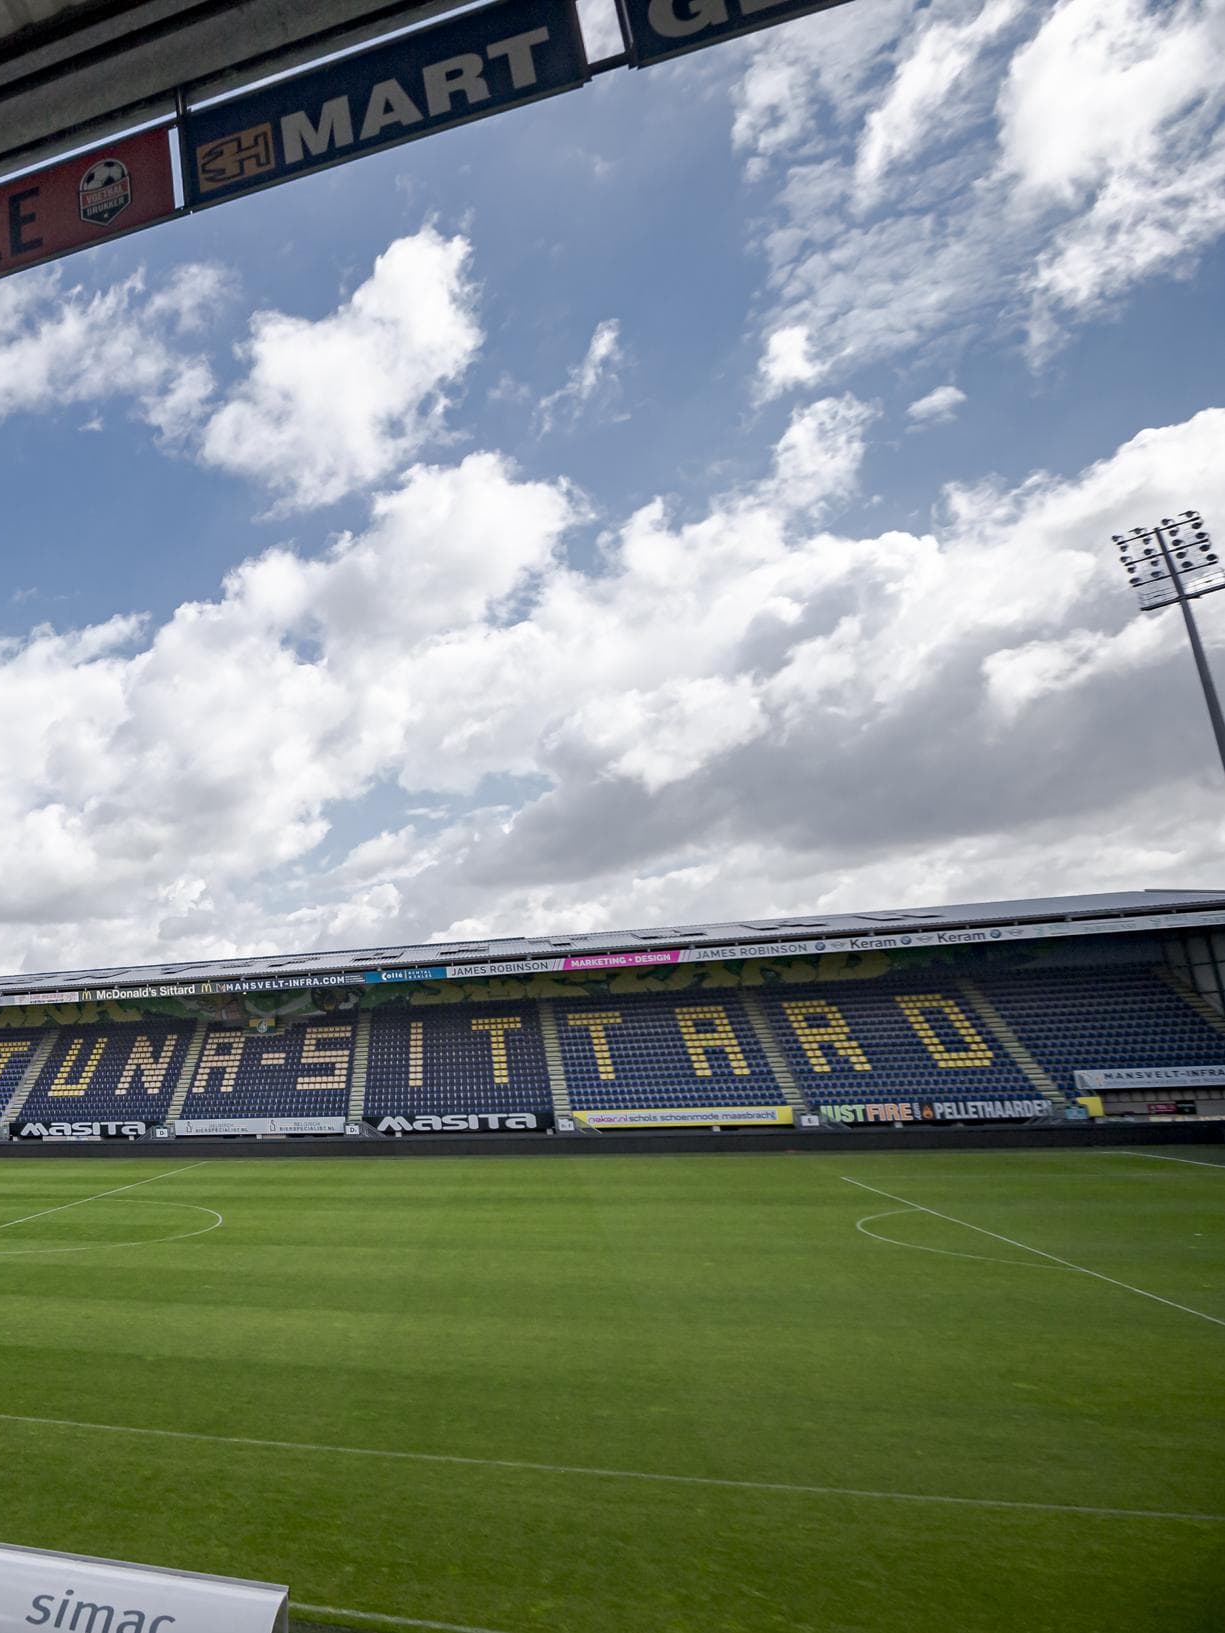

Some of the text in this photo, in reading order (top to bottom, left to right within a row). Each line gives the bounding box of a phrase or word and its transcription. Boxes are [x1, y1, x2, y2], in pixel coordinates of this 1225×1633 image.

[278, 27, 552, 164] MART
[849, 936, 897, 950] Keram
[936, 930, 986, 944] Keram
[695, 943, 807, 960] JAMES ROBINSON
[570, 953, 671, 968] MARKETING DESIGN
[451, 961, 549, 977] JAMES ROBINSON
[96, 984, 196, 1000] McDonald's Sittard
[226, 976, 346, 992] MANSVELT-INFRA.COM
[629, 1114, 658, 1122] schols
[659, 1112, 719, 1122] schoenmode
[24, 1589, 176, 1633] simac
